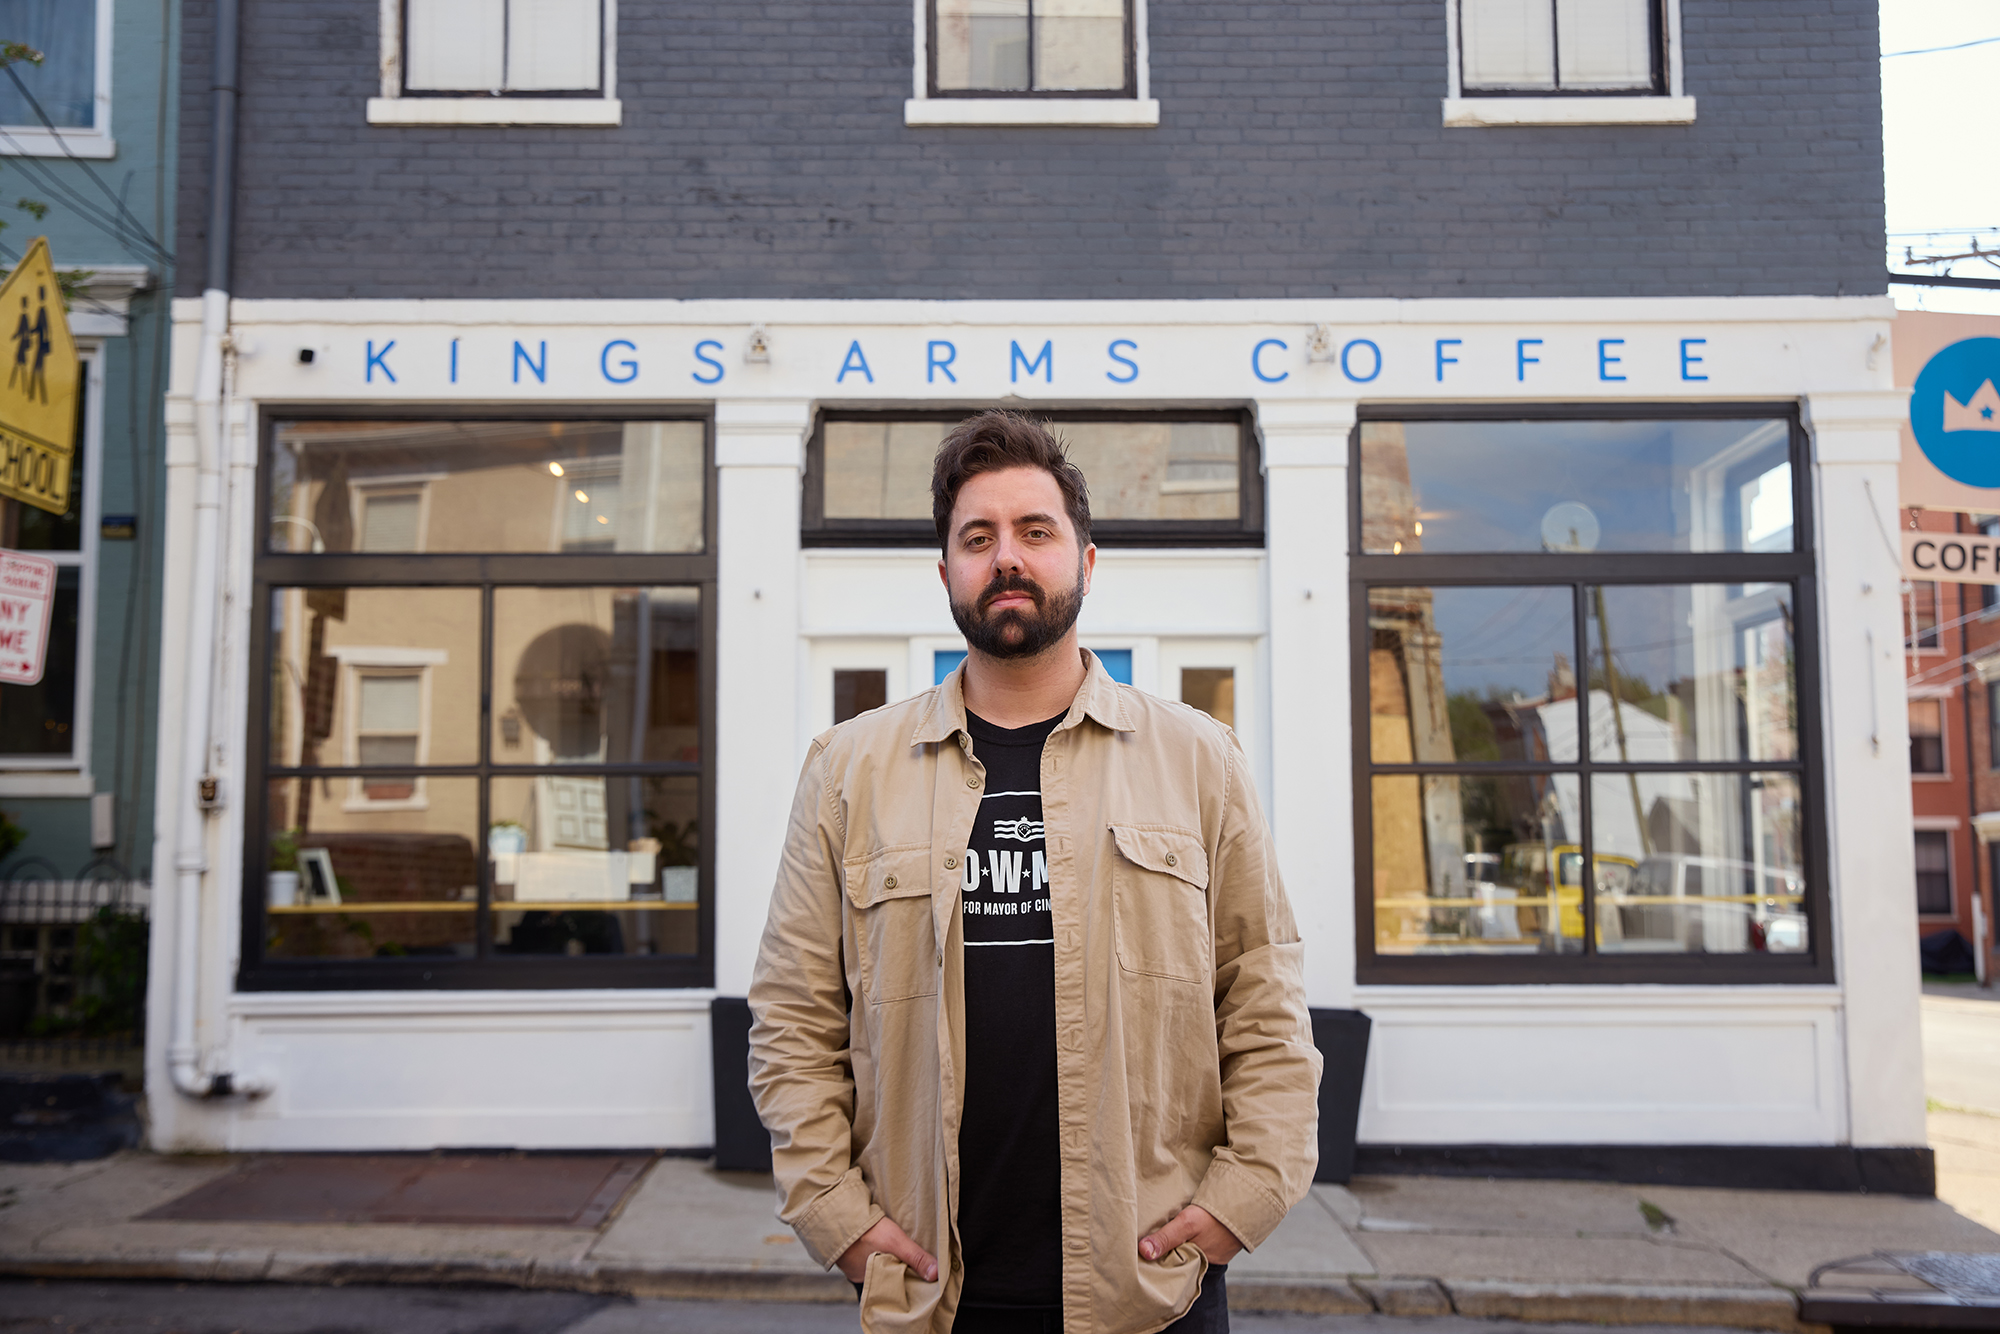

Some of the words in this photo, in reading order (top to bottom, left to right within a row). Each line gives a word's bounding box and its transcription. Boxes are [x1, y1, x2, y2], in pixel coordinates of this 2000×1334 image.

[365, 338, 726, 385] KINGS
[835, 338, 1141, 384] ARMS
[1250, 338, 1710, 383] COFFEE
[1911, 540, 2000, 574] COF
[963, 901, 981, 915] FOR
[983, 902, 1018, 916] MAYOR
[1020, 900, 1032, 915] OF
